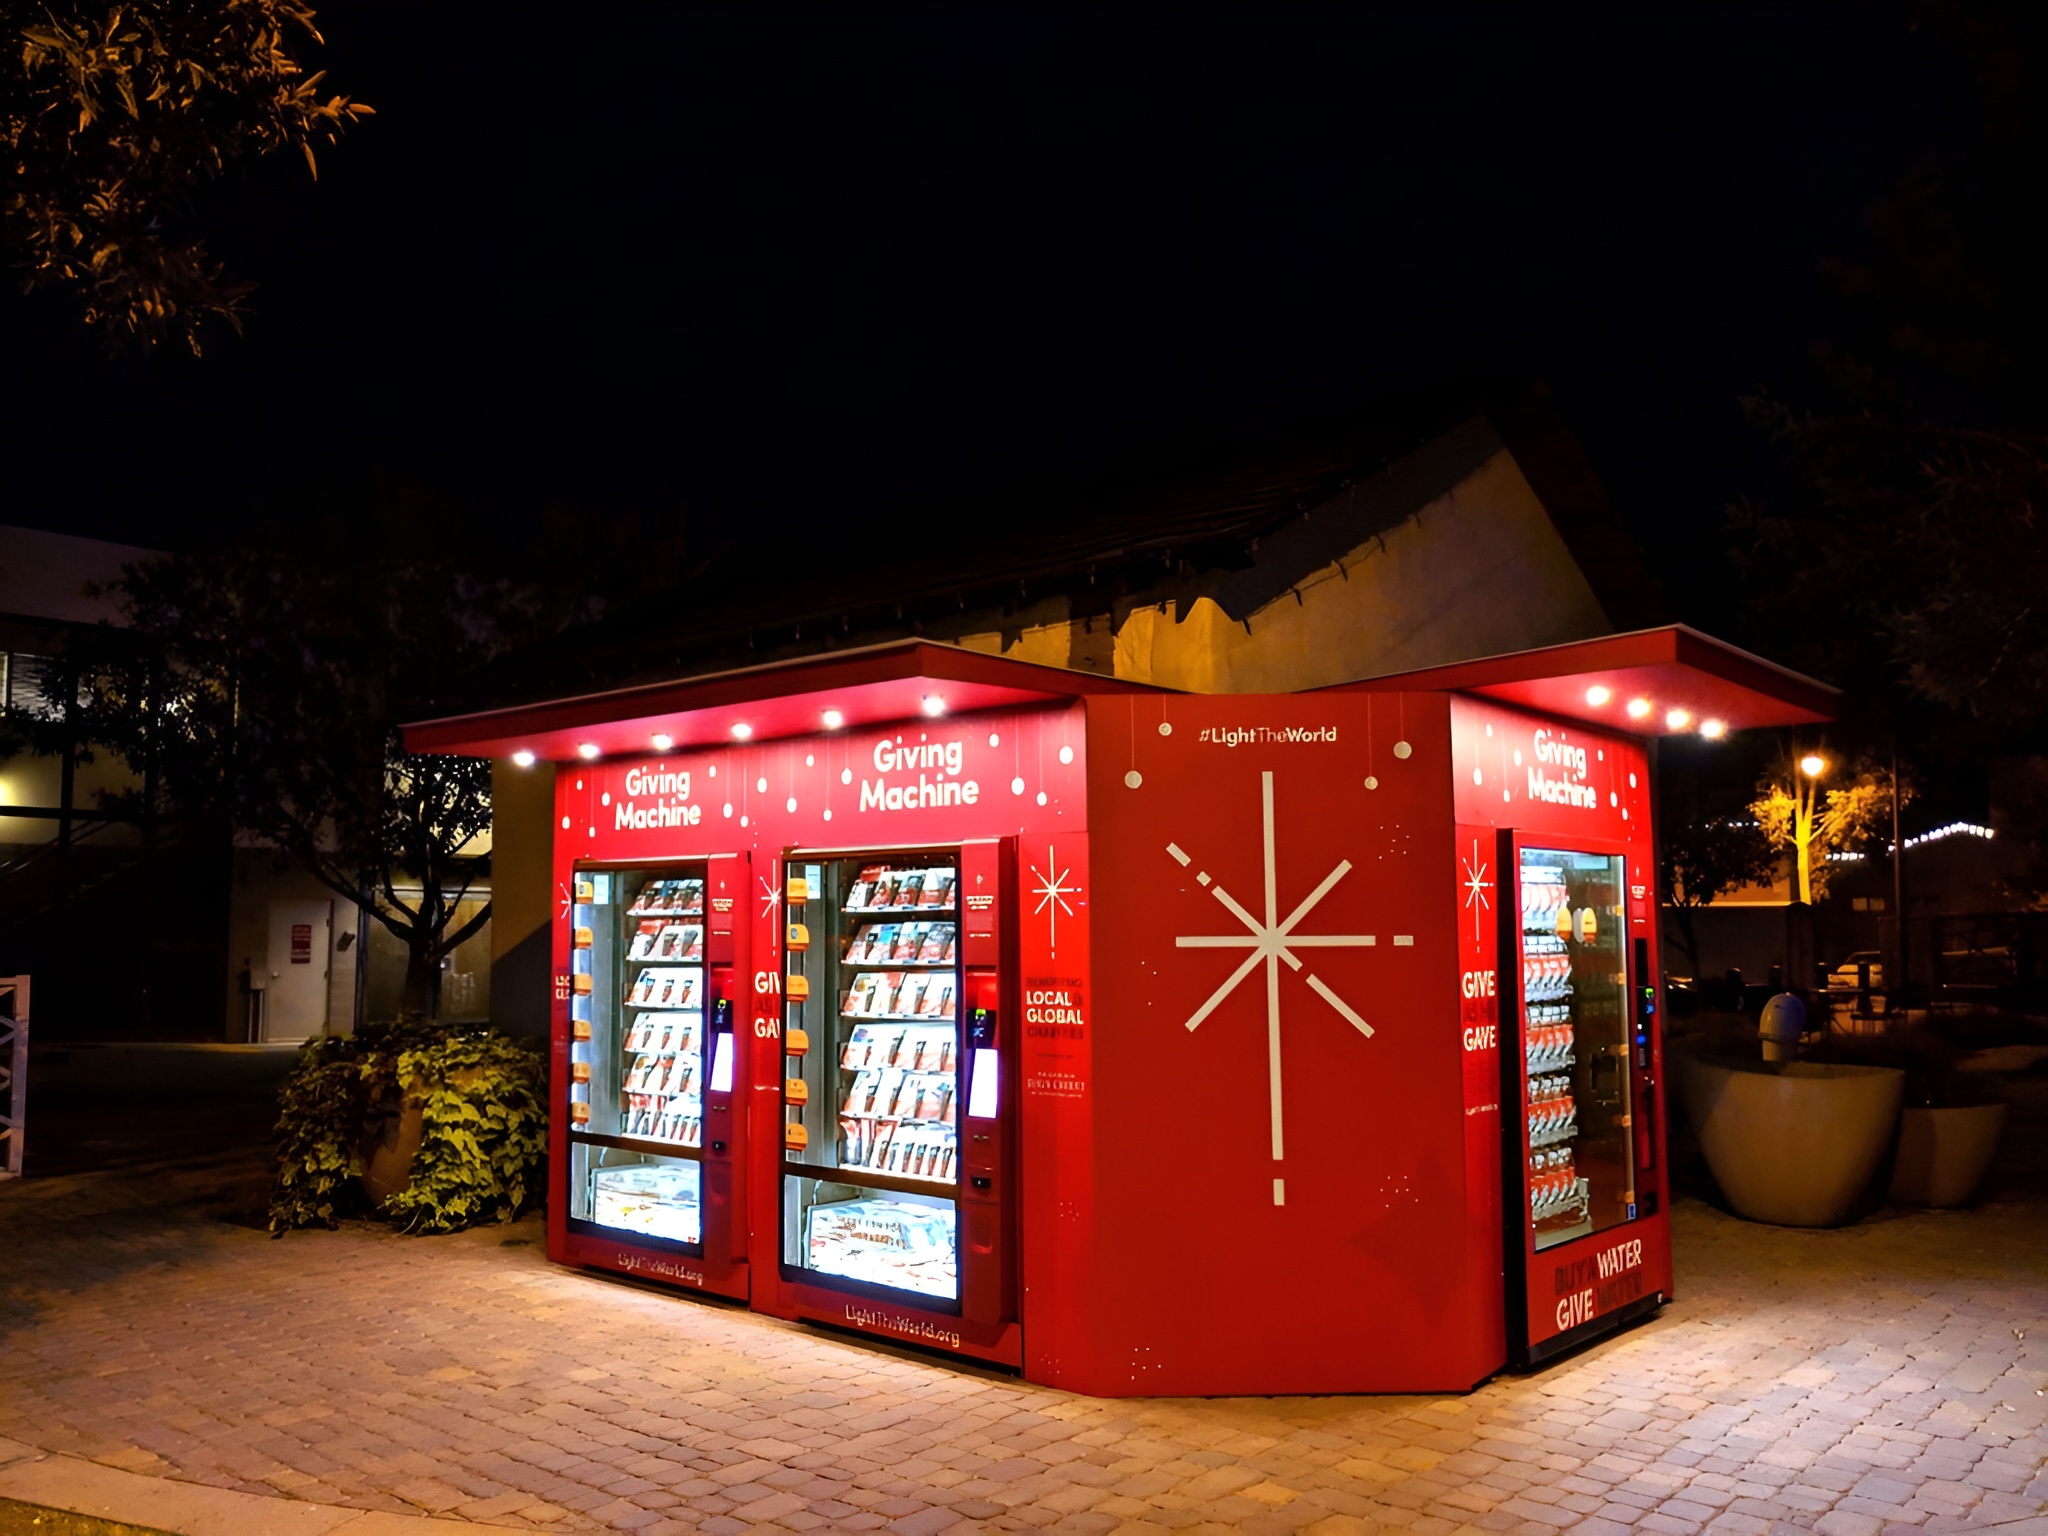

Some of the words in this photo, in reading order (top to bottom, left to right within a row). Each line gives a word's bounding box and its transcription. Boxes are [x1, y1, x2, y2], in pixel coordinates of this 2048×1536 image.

[873, 733, 963, 776] Giving
[1198, 726, 1337, 748] #LightTheWorld
[1533, 728, 1587, 780] Giving
[625, 763, 691, 801] Giving
[858, 773, 980, 813] Machine
[1527, 766, 1597, 809] Machine
[614, 800, 702, 831] Machine
[1026, 990, 1072, 1006] LOCAL
[1461, 970, 1496, 999] GIVE
[1026, 1007, 1084, 1025] GLOBAL
[1463, 1025, 1497, 1052] GAVE
[1597, 1238, 1642, 1280] WATER
[1556, 1287, 1594, 1332] GIVE
